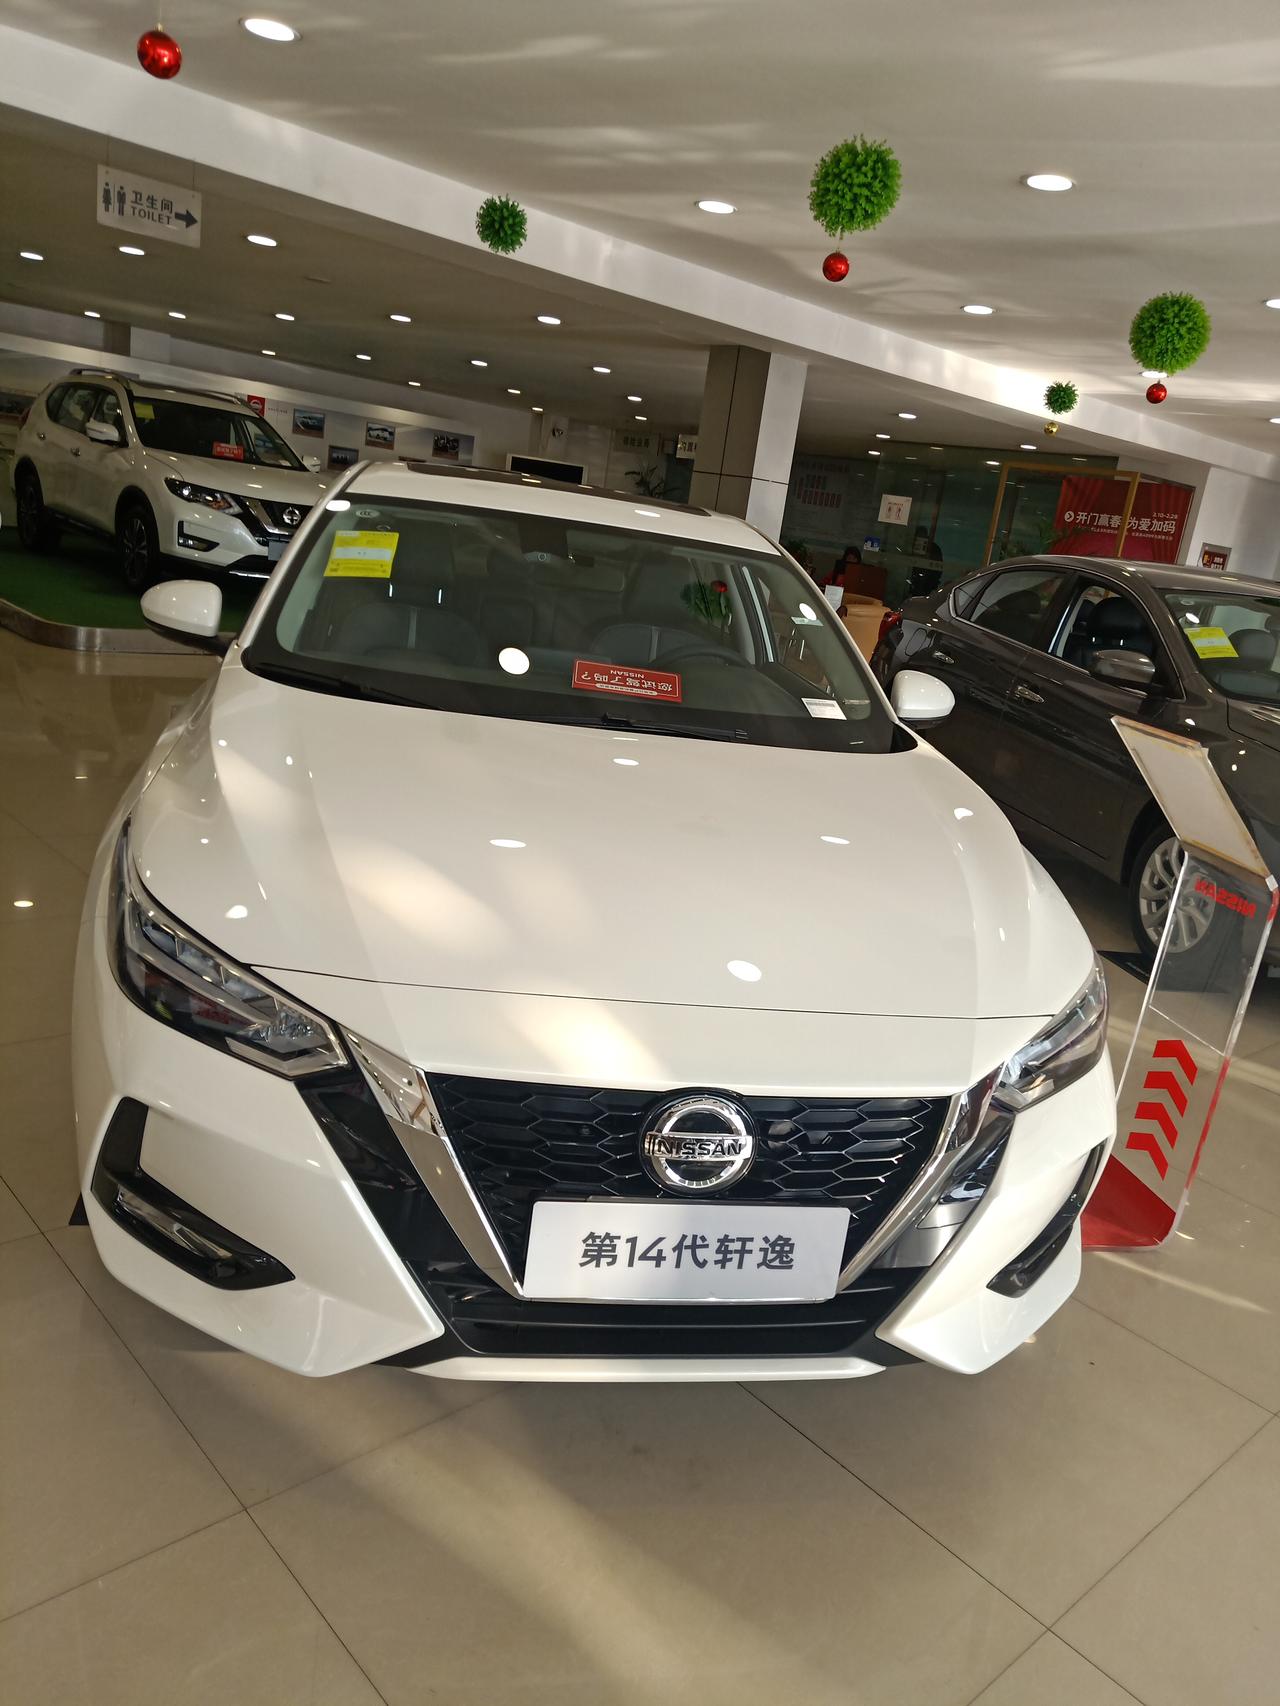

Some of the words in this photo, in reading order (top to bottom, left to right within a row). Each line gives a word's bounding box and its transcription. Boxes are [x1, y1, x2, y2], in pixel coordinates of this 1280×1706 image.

[130, 190, 173, 215] 卫生间
[130, 206, 172, 225] TOILET
[610, 669, 645, 679] NISSAN
[656, 1138, 742, 1156] NISSAN
[578, 1231, 796, 1270] 第14代轩逸
